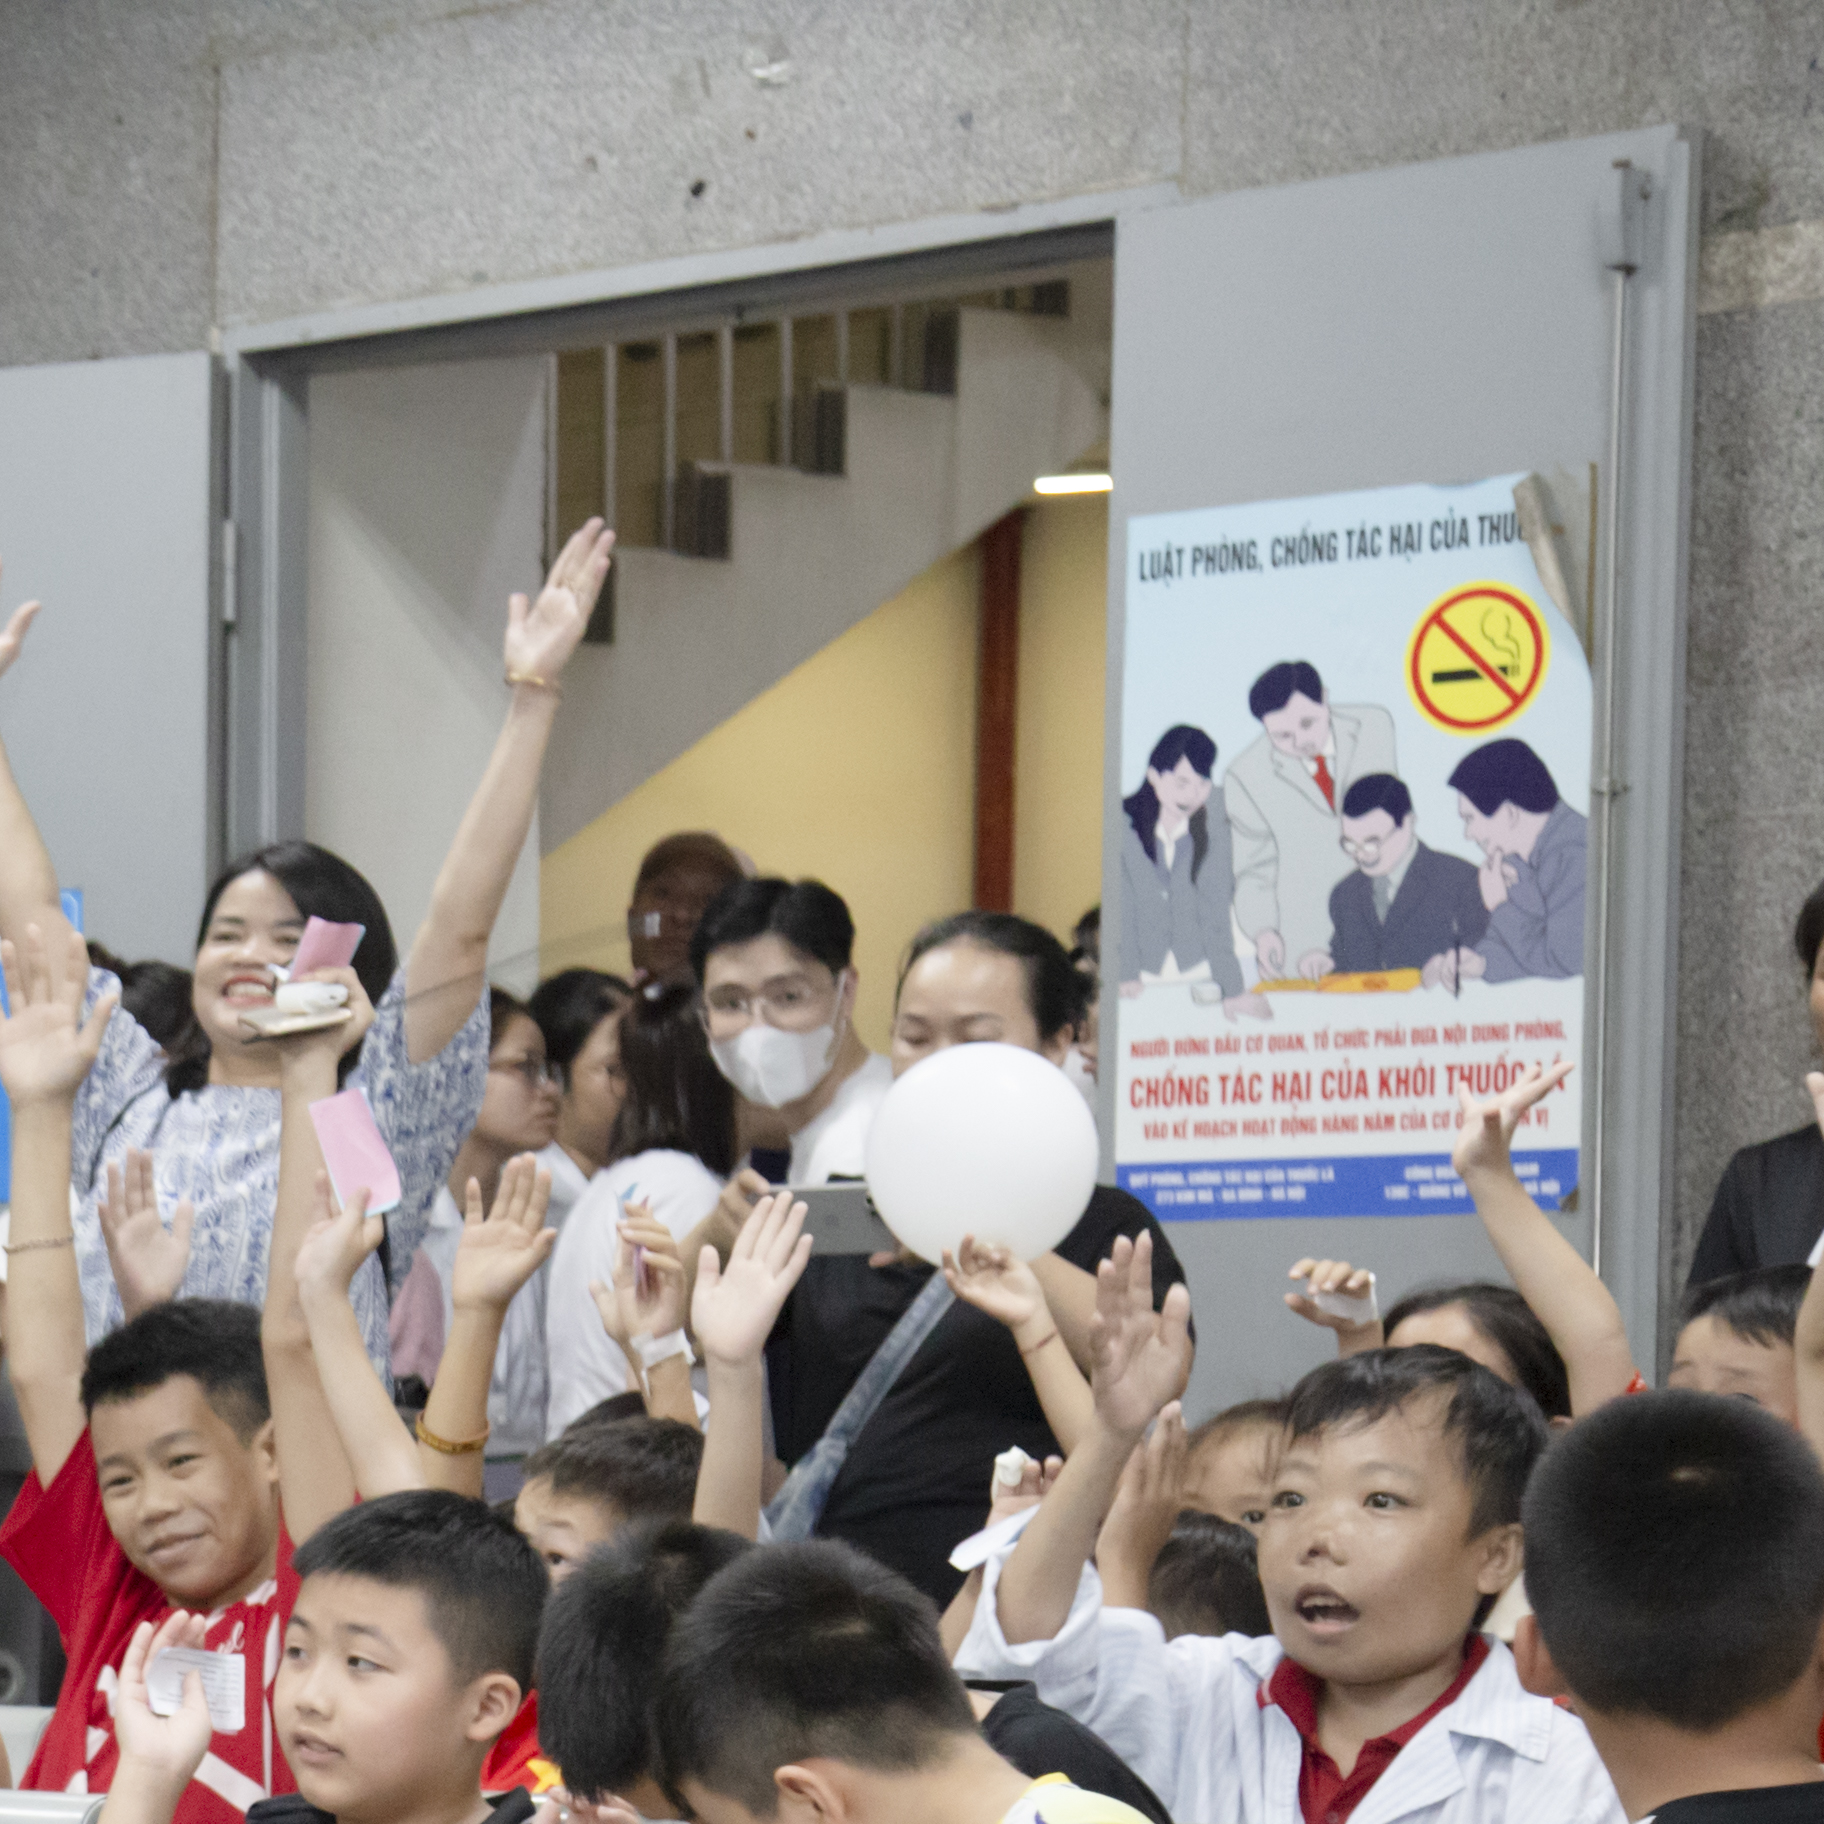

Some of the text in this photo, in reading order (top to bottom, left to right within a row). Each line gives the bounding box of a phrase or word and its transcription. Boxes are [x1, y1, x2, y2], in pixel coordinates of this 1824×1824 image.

[1139, 541, 1184, 587] LUẬT
[1191, 535, 1265, 579] PHÒNG,
[1271, 519, 1338, 570] CHỐNG
[1346, 517, 1382, 562] TÁC
[1389, 521, 1422, 564] HẠI
[1430, 507, 1470, 553] CỦA
[1130, 1063, 1209, 1109] CHỐNG
[1218, 1064, 1263, 1106] TÁC
[1272, 1070, 1311, 1112] HẠI
[1321, 1056, 1369, 1101] CỦA
[1378, 1058, 1436, 1099] KHÓI
